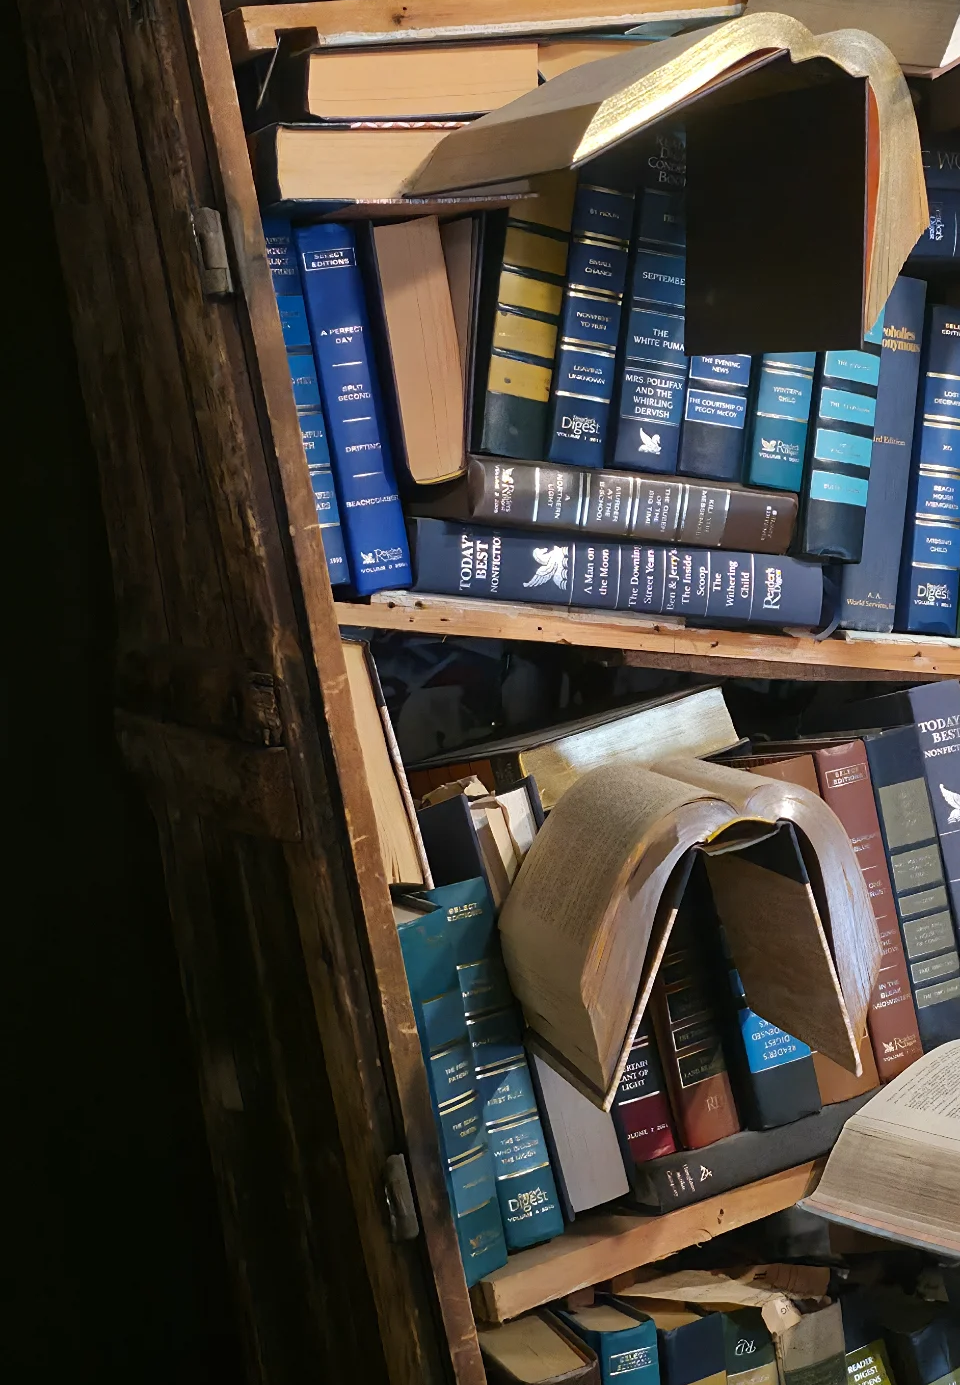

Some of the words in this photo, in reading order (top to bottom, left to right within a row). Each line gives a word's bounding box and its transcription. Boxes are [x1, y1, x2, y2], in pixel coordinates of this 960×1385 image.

[643, 272, 685, 286] SEPTEMBE
[329, 326, 363, 335] PERFECT
[653, 329, 669, 337] THE
[634, 336, 660, 346] WHITE
[663, 341, 684, 351] PUMA
[712, 366, 729, 374] NEWS
[715, 358, 740, 368] EVENING
[626, 375, 645, 383] MRS.
[647, 378, 683, 389] POLLIFAX
[636, 387, 653, 395] AND
[656, 389, 672, 398] THE
[633, 396, 673, 409] WHIRLING
[702, 399, 735, 410] COURTSHIP
[635, 406, 669, 418] DERVISH
[695, 406, 715, 414] PEGGY
[562, 417, 600, 434] Digest
[885, 436, 906, 445] Edition
[345, 443, 381, 453] DRIFTING
[555, 474, 563, 519] NORTHERN
[588, 547, 595, 557] on
[476, 541, 488, 579] BEST
[600, 549, 609, 577] Moon
[585, 560, 593, 583] Man
[683, 555, 692, 581] Inside
[599, 579, 607, 595] the
[669, 582, 676, 590] &
[697, 567, 708, 596] Scoop
[713, 573, 721, 592] The
[726, 561, 738, 607] Withering
[741, 573, 750, 598] Child
[763, 568, 780, 609] Reader's
[585, 584, 592, 594] A
[644, 575, 654, 604] Street
[682, 584, 690, 605] The
[629, 586, 638, 607] The
[932, 728, 960, 743] BEST
[764, 1035, 790, 1049] DIGEST
[763, 1045, 796, 1060] READER'S
[622, 1080, 645, 1091] LIGHT
